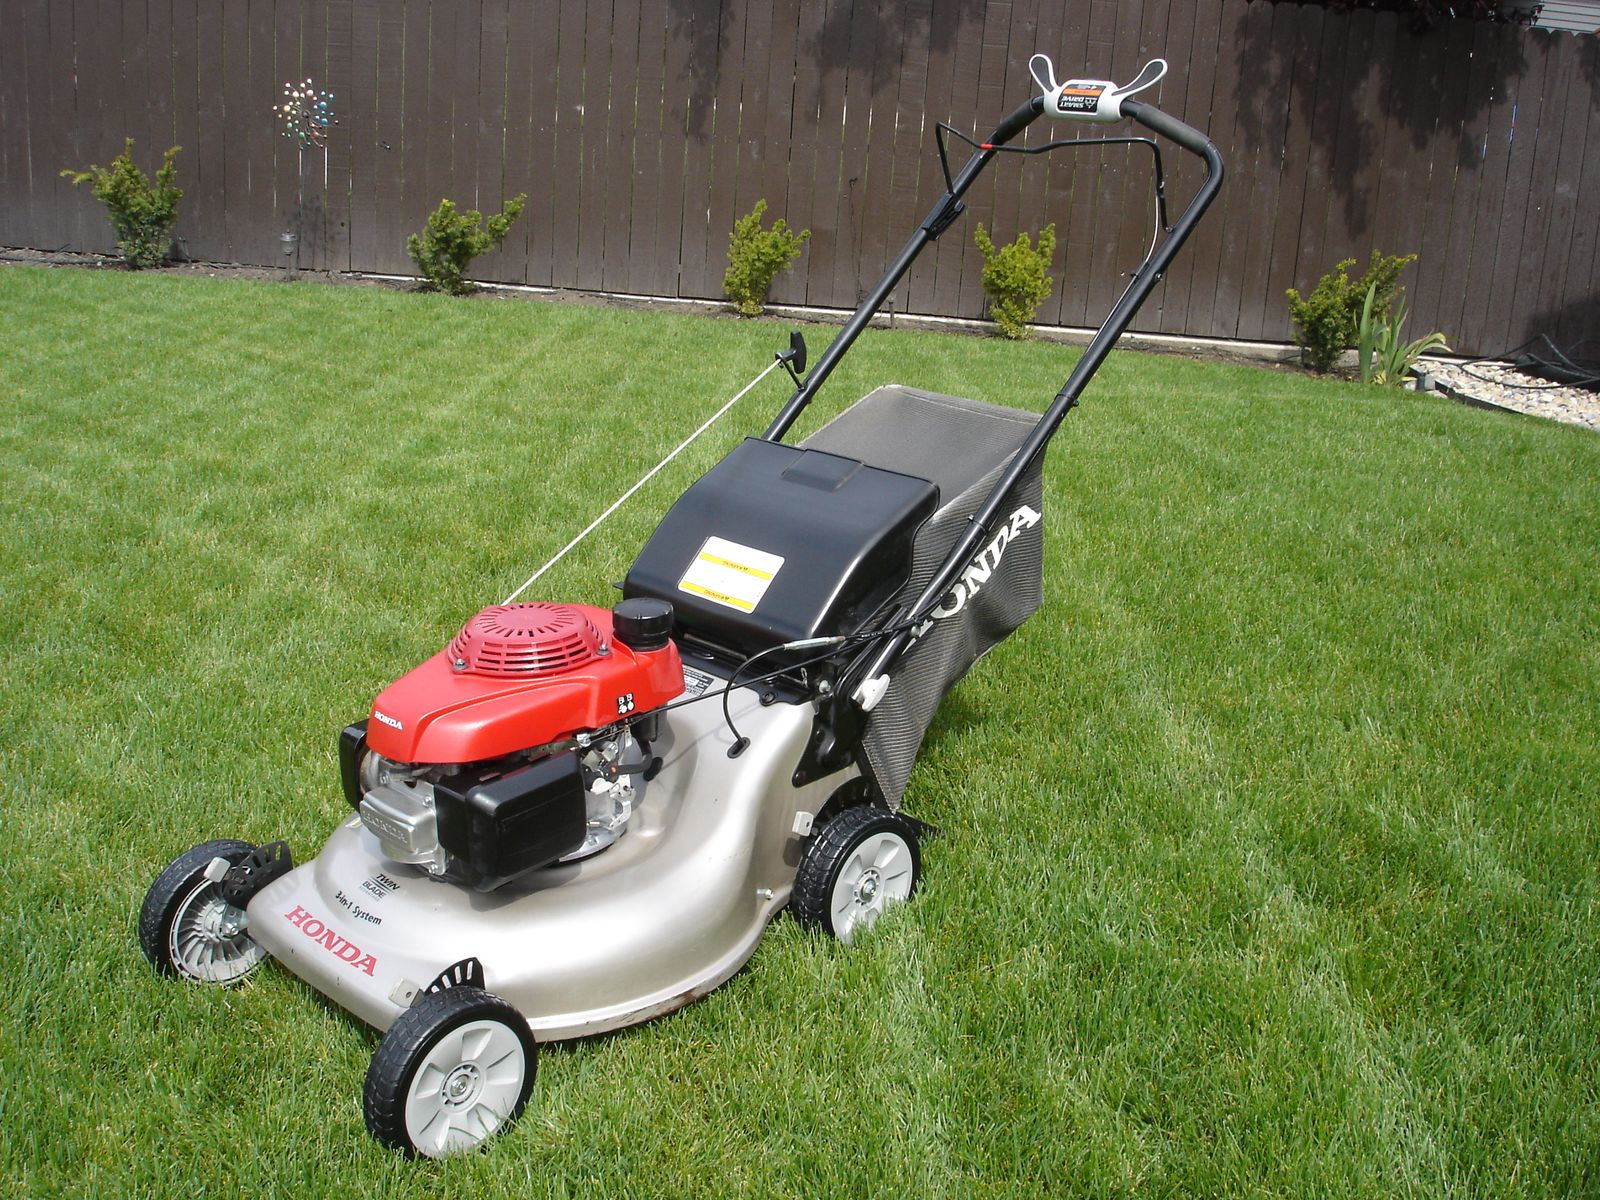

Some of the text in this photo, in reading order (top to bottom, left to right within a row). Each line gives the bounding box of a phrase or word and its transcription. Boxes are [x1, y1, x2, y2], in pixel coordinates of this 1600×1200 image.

[374, 710, 403, 730] HONDA
[362, 881, 388, 899] BLADE
[376, 873, 401, 891] TWIN
[335, 890, 353, 910] 3-in-1
[352, 905, 383, 926] System
[284, 905, 378, 977] HONDA
